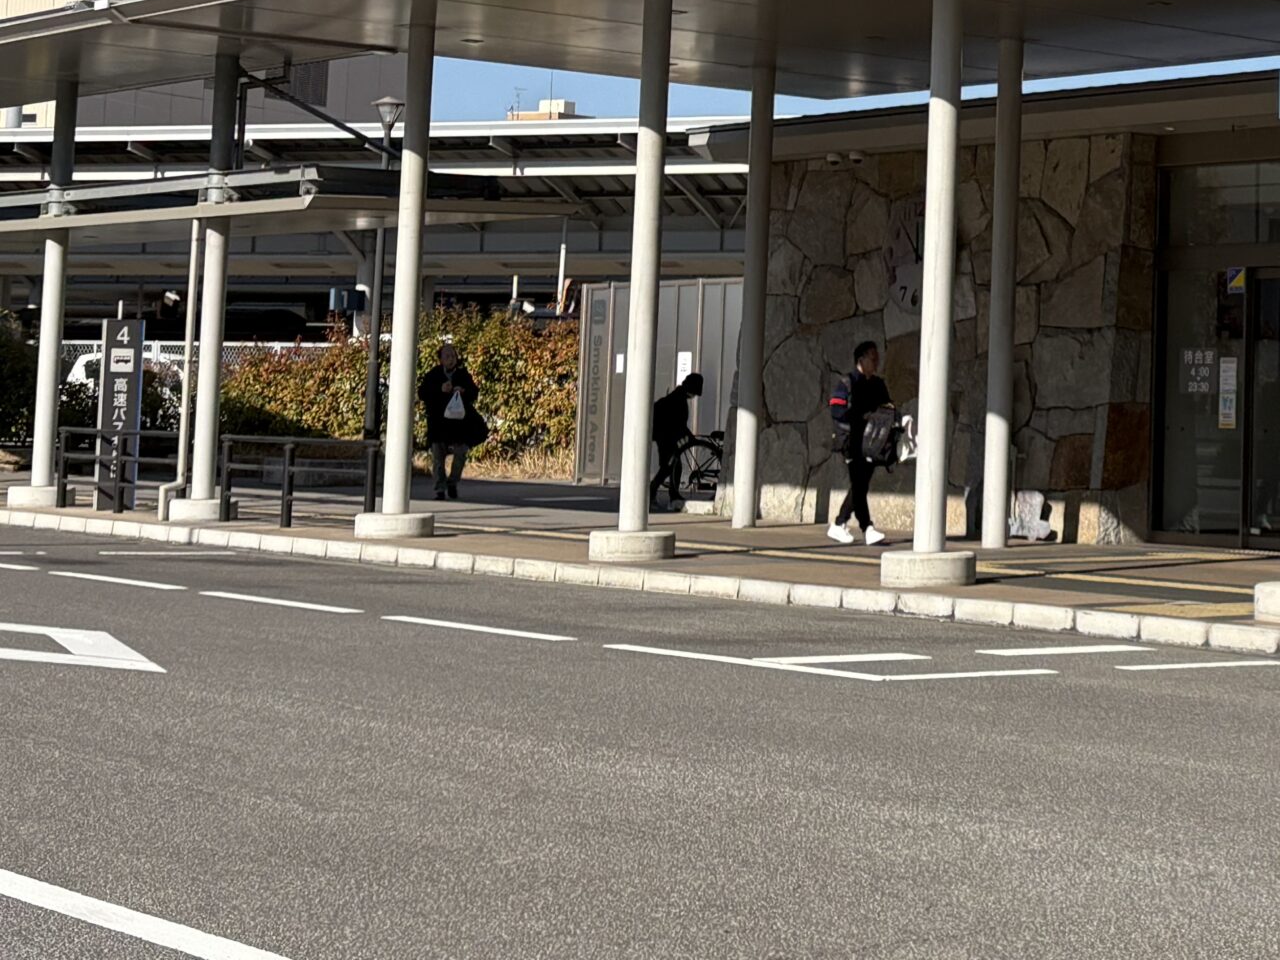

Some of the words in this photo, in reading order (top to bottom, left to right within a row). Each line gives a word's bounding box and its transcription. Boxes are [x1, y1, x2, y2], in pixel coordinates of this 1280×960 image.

[899, 286, 908, 302] 7
[116, 325, 130, 345] 4
[588, 335, 603, 415] Smoking
[587, 422, 599, 463] Area
